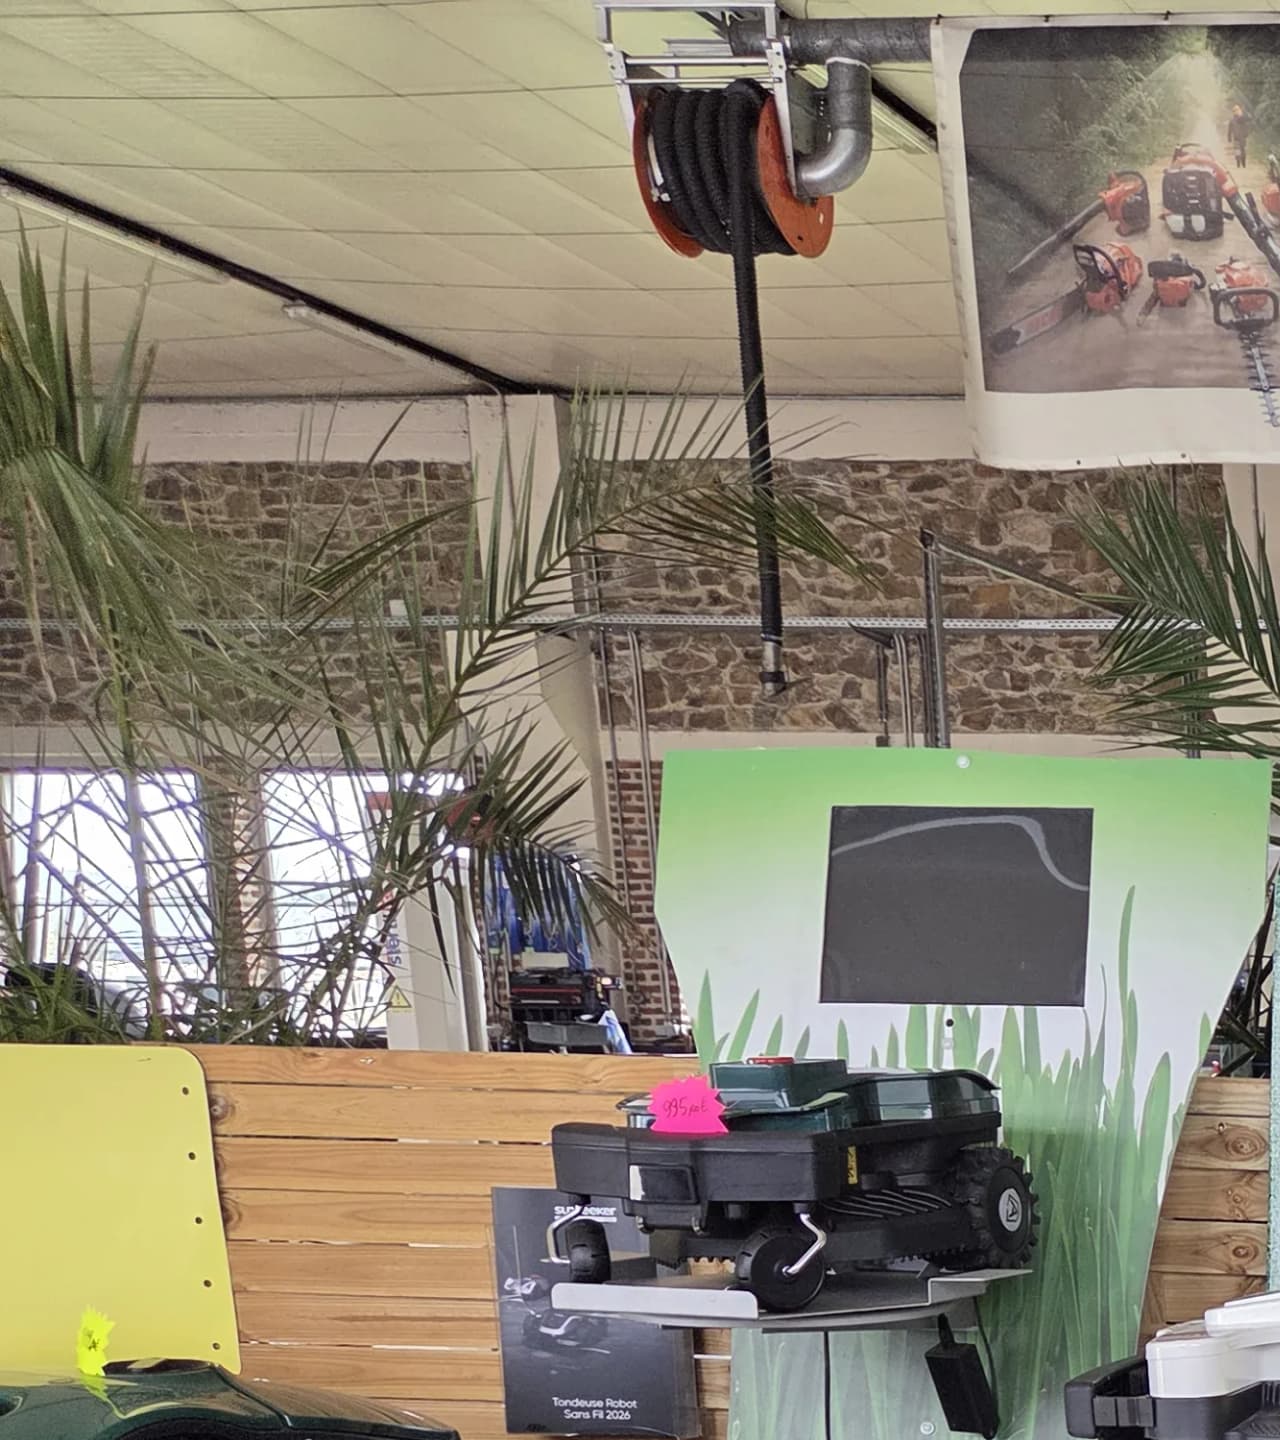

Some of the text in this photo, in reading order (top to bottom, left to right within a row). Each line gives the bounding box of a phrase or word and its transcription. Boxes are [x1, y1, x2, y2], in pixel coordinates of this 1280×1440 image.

[552, 1397, 638, 1409] Tondeuse Robot
[564, 1409, 631, 1420] Sans Fil 2026
